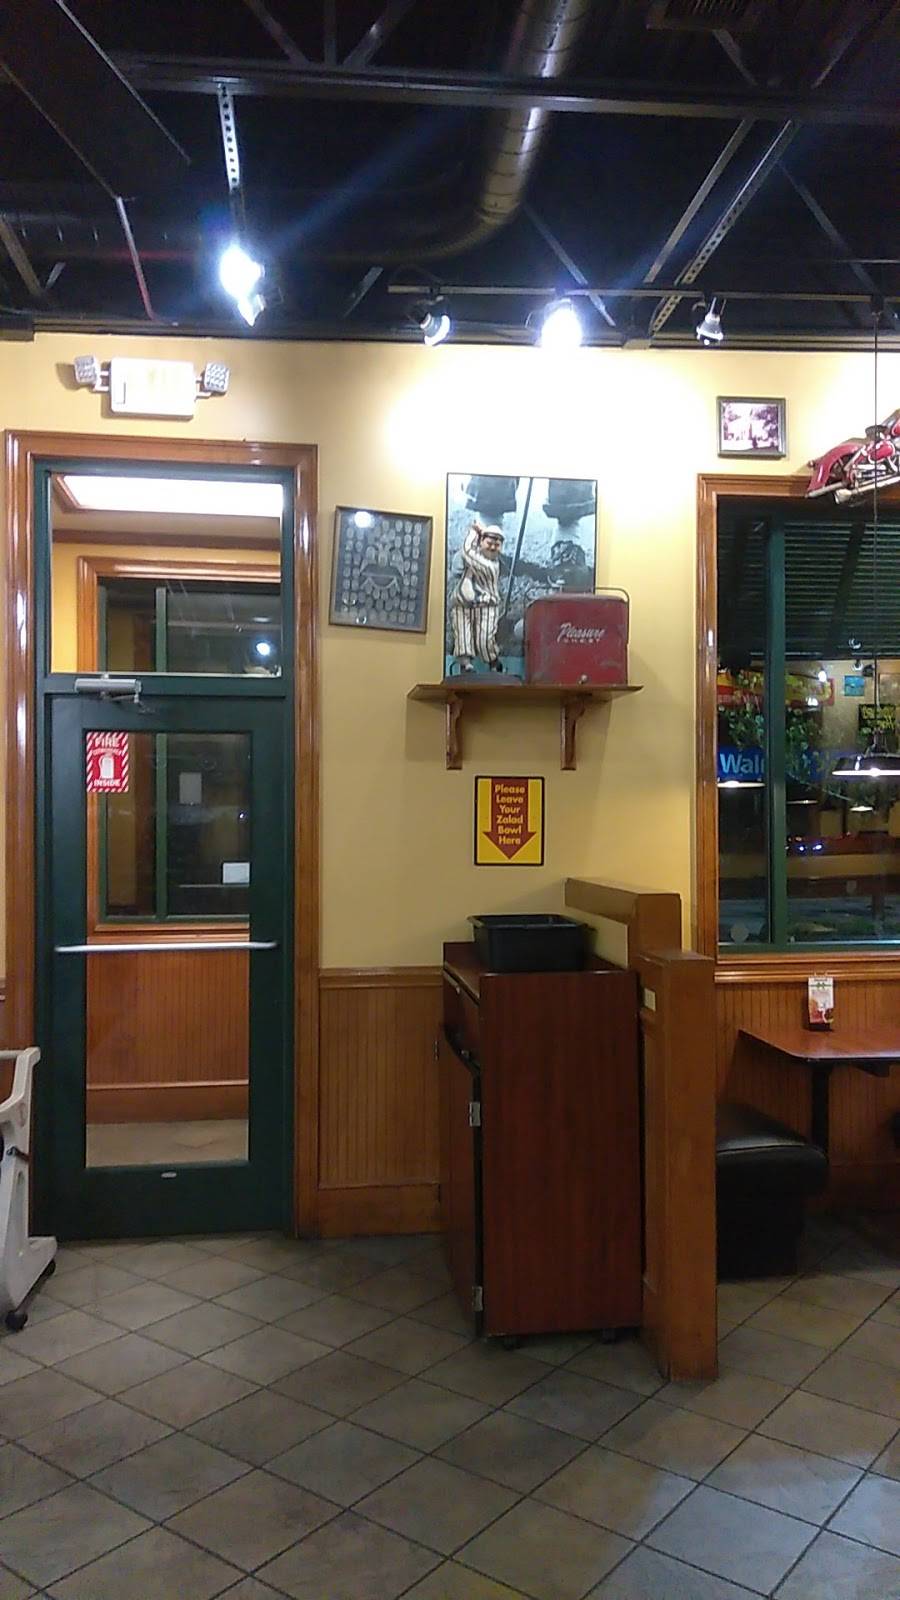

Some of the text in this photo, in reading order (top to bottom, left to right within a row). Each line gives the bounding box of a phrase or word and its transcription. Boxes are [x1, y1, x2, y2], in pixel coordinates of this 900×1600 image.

[95, 736, 120, 747] FIRE
[494, 783, 526, 794] Please
[495, 794, 524, 804] Leave
[499, 804, 520, 814] Your
[496, 814, 524, 824] Zalad
[497, 825, 522, 834] Bowl
[498, 835, 521, 845] Here
